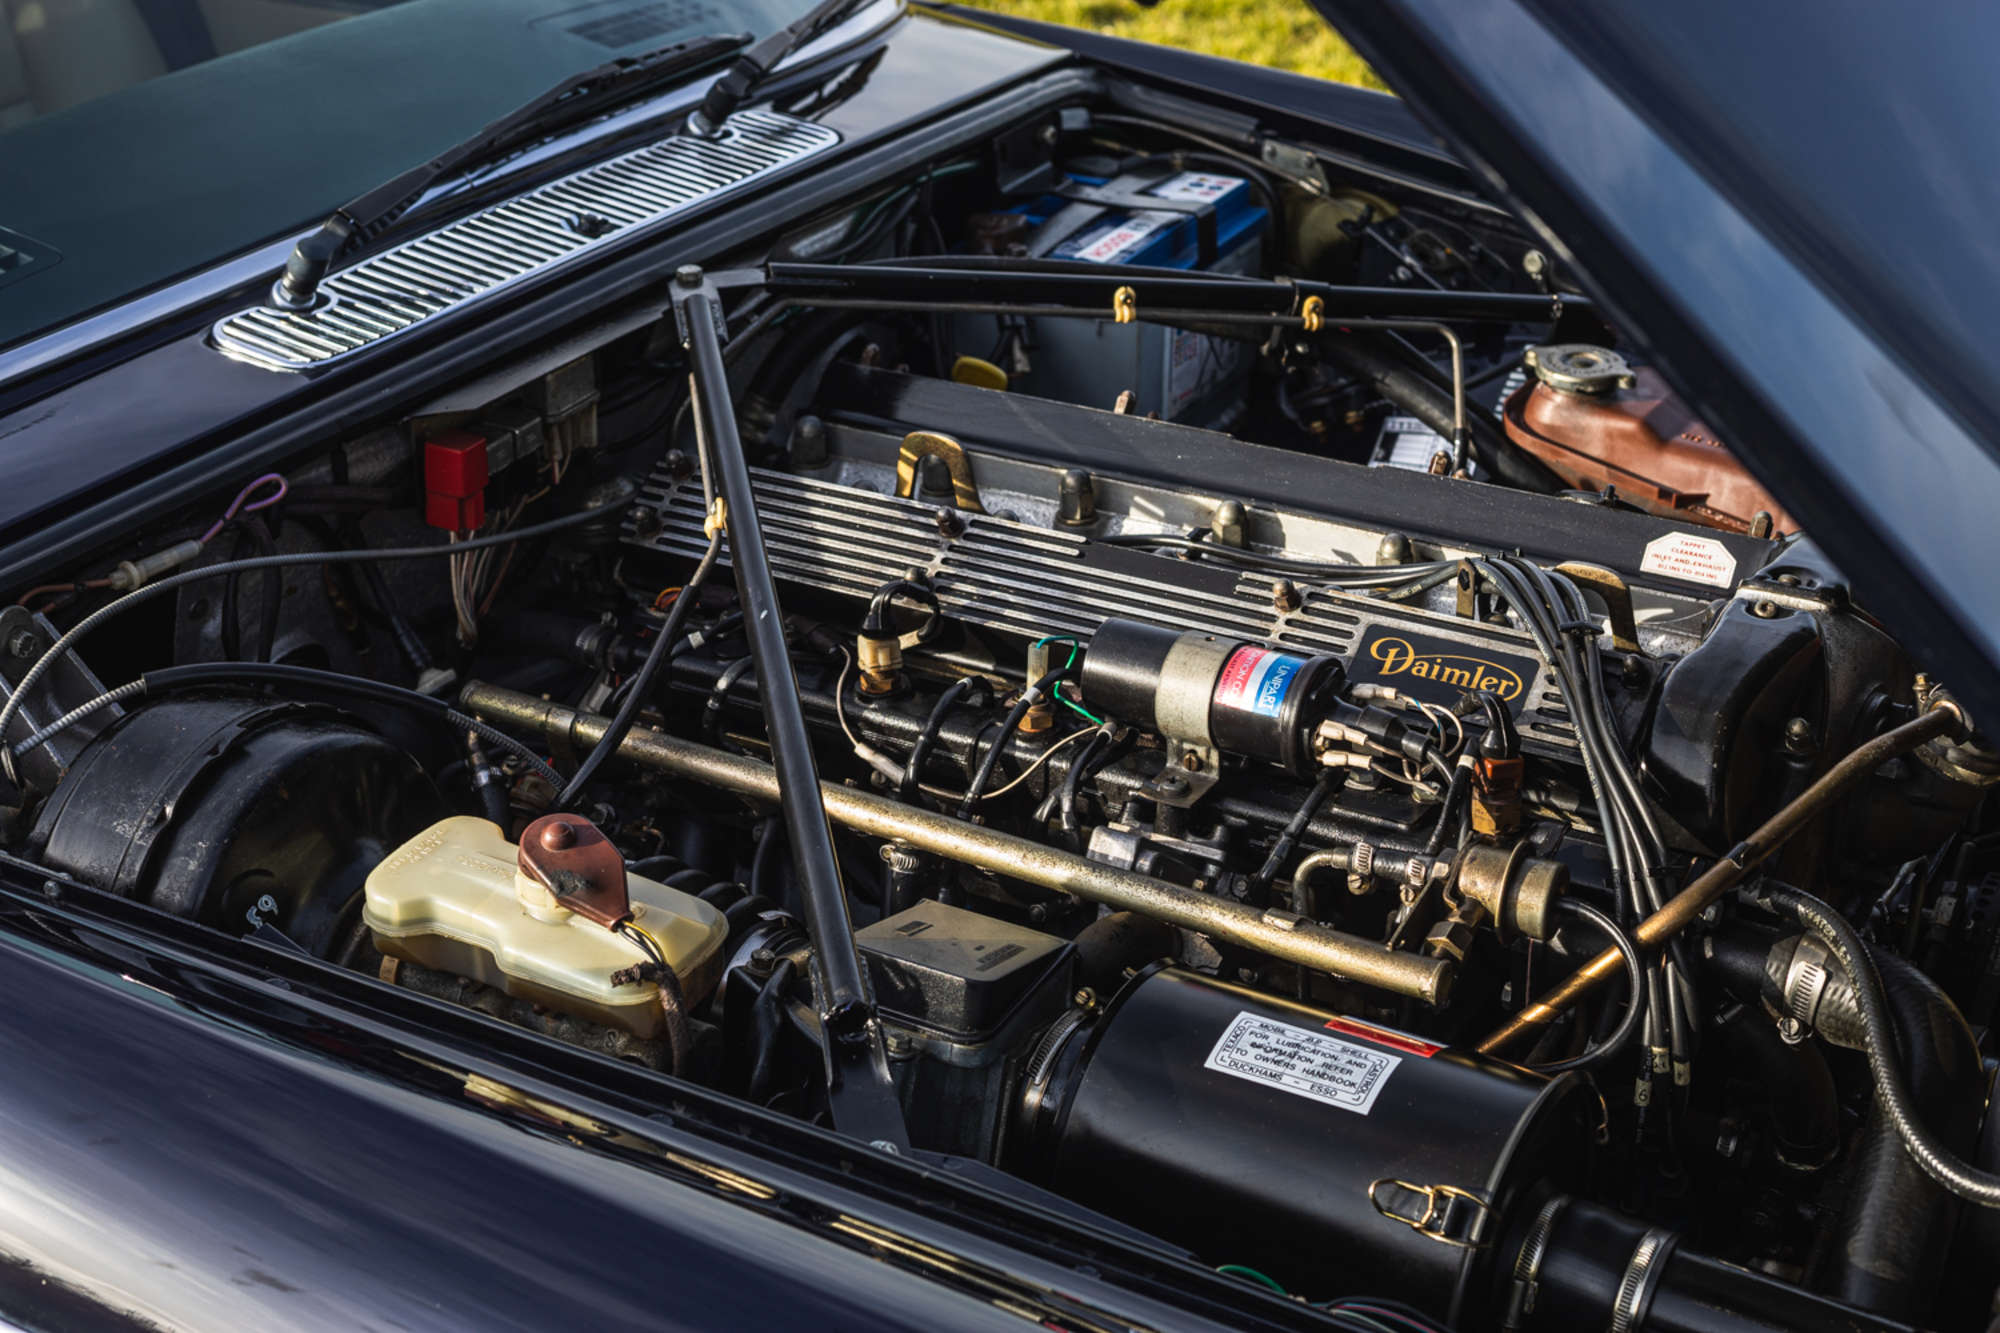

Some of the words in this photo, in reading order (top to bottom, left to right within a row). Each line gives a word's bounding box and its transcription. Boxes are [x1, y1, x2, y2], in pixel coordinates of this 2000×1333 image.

[1671, 547, 1712, 560] CLEARANCE
[1680, 540, 1706, 549] TAPPET
[1651, 553, 1672, 562] INLET
[1674, 557, 1690, 565] AND
[1692, 561, 1726, 572] EXHAUST
[1370, 636, 1523, 701] Daimler
[1262, 664, 1290, 710] UNIPART
[1222, 1025, 1246, 1052] TEXACO
[1248, 1030, 1270, 1041] FOR
[1276, 1038, 1338, 1061] LUBRICATION
[1345, 1059, 1367, 1069] AND
[1259, 1023, 1285, 1034] MOBIL
[1341, 1045, 1369, 1059] SHELL
[1234, 1047, 1248, 1057] TO
[1254, 1053, 1297, 1071] OWNERS
[1302, 1067, 1358, 1088] HANDBOOK
[1249, 1041, 1314, 1064] INFORMATION
[1321, 1062, 1354, 1076] REFER
[1228, 1059, 1284, 1081] DUCKHAMS
[1310, 1083, 1338, 1097] ESSO
[1357, 1062, 1384, 1095] CASTROL
